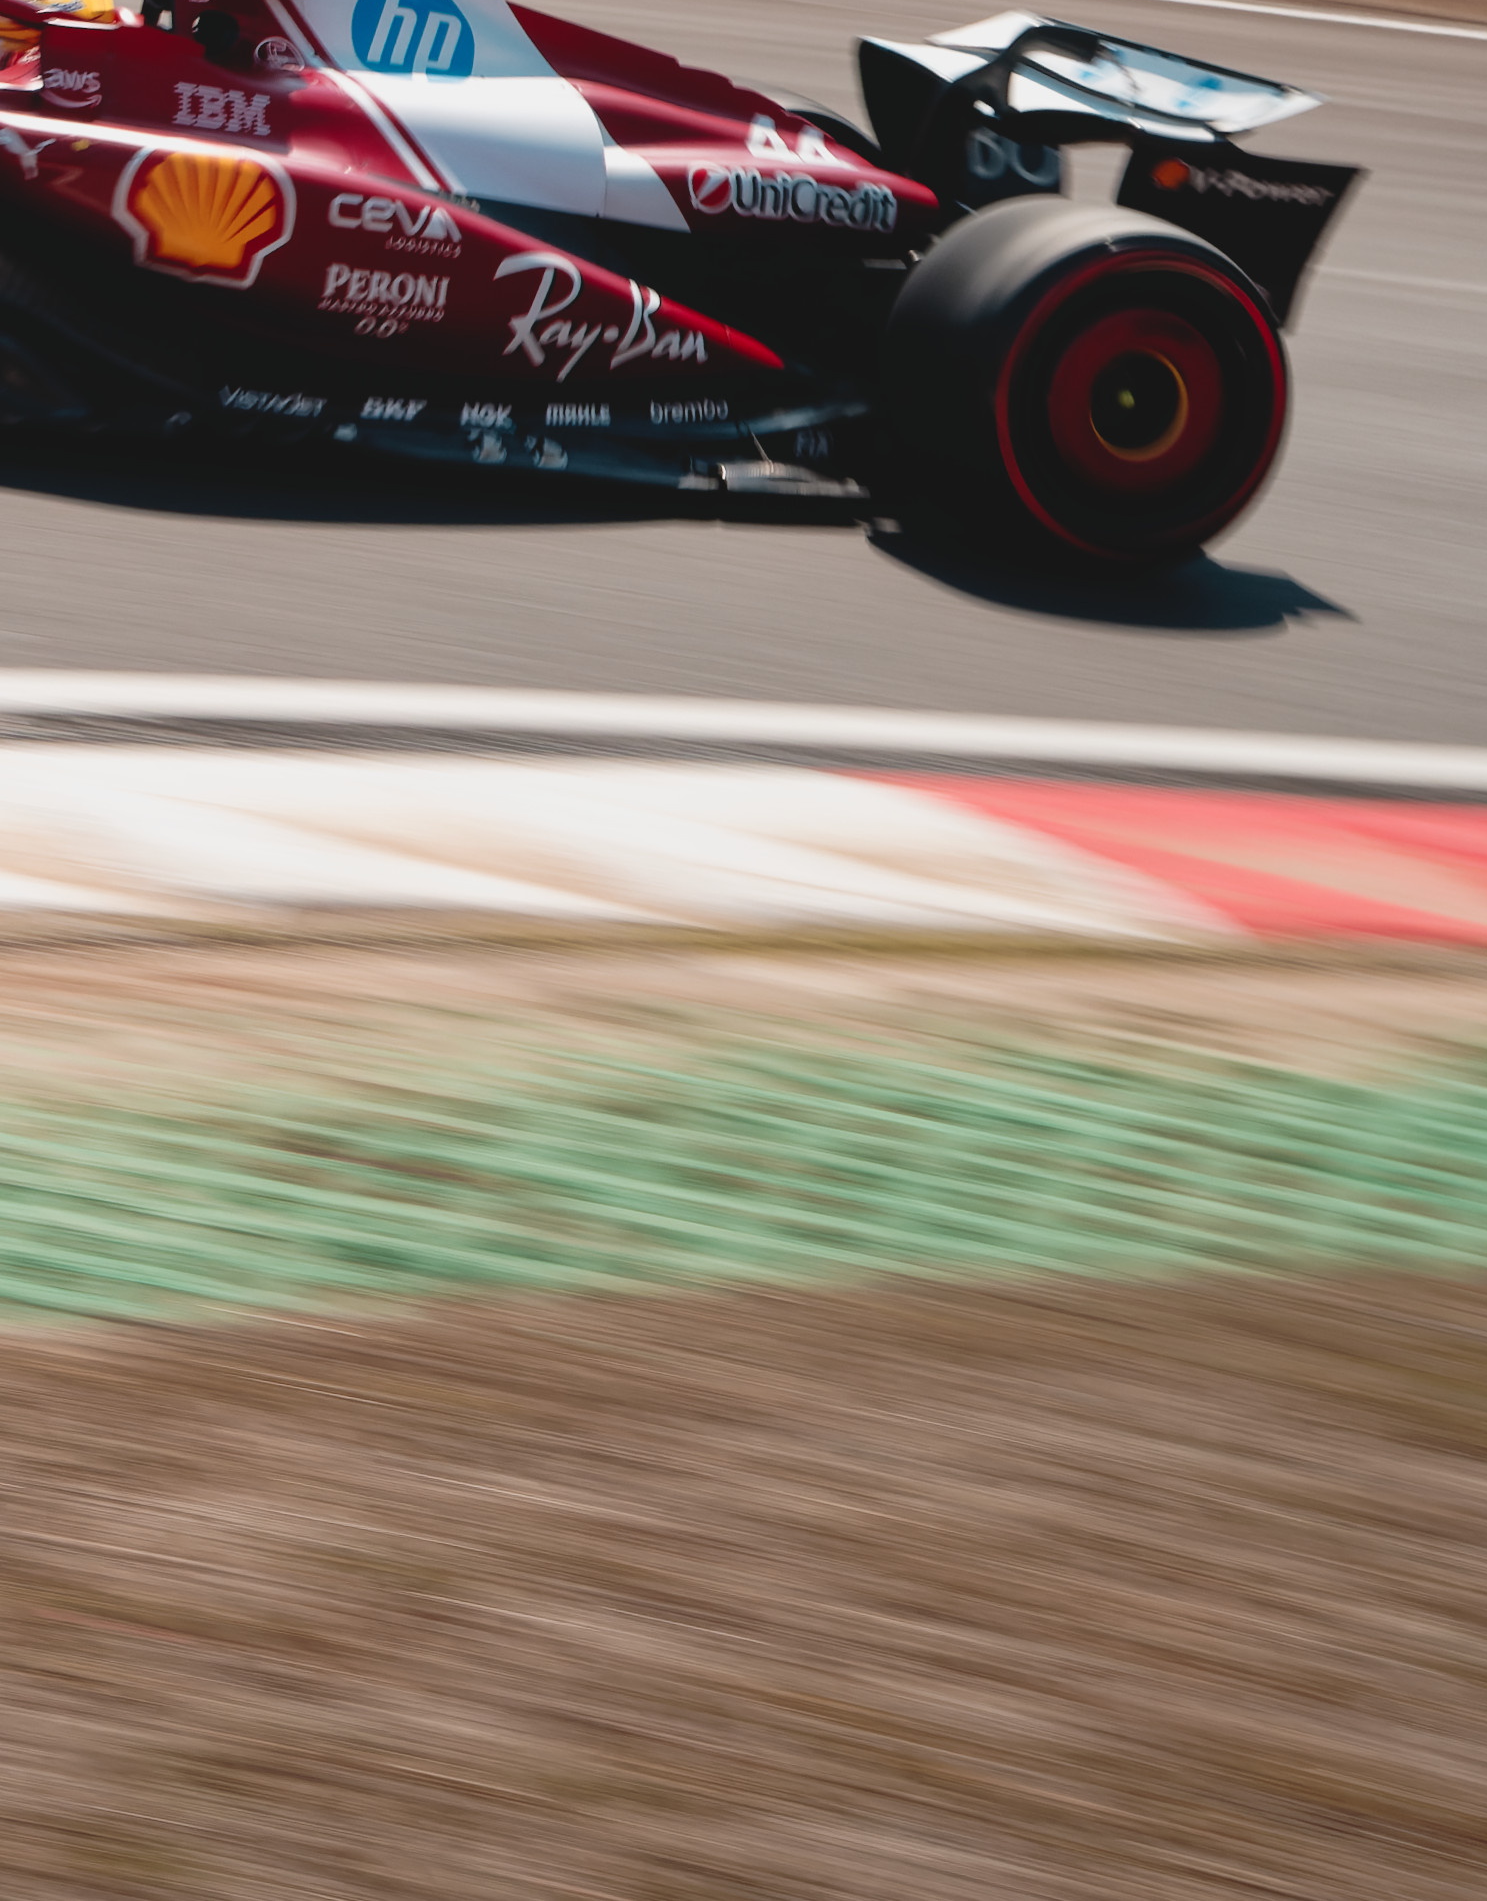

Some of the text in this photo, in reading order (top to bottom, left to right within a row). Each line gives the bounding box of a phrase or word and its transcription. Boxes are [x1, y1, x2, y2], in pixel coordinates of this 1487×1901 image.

[44, 68, 101, 93] aws
[172, 81, 271, 136] IBM
[746, 112, 859, 172] 44
[731, 166, 898, 234] UniCredit
[322, 262, 451, 307] PERONI
